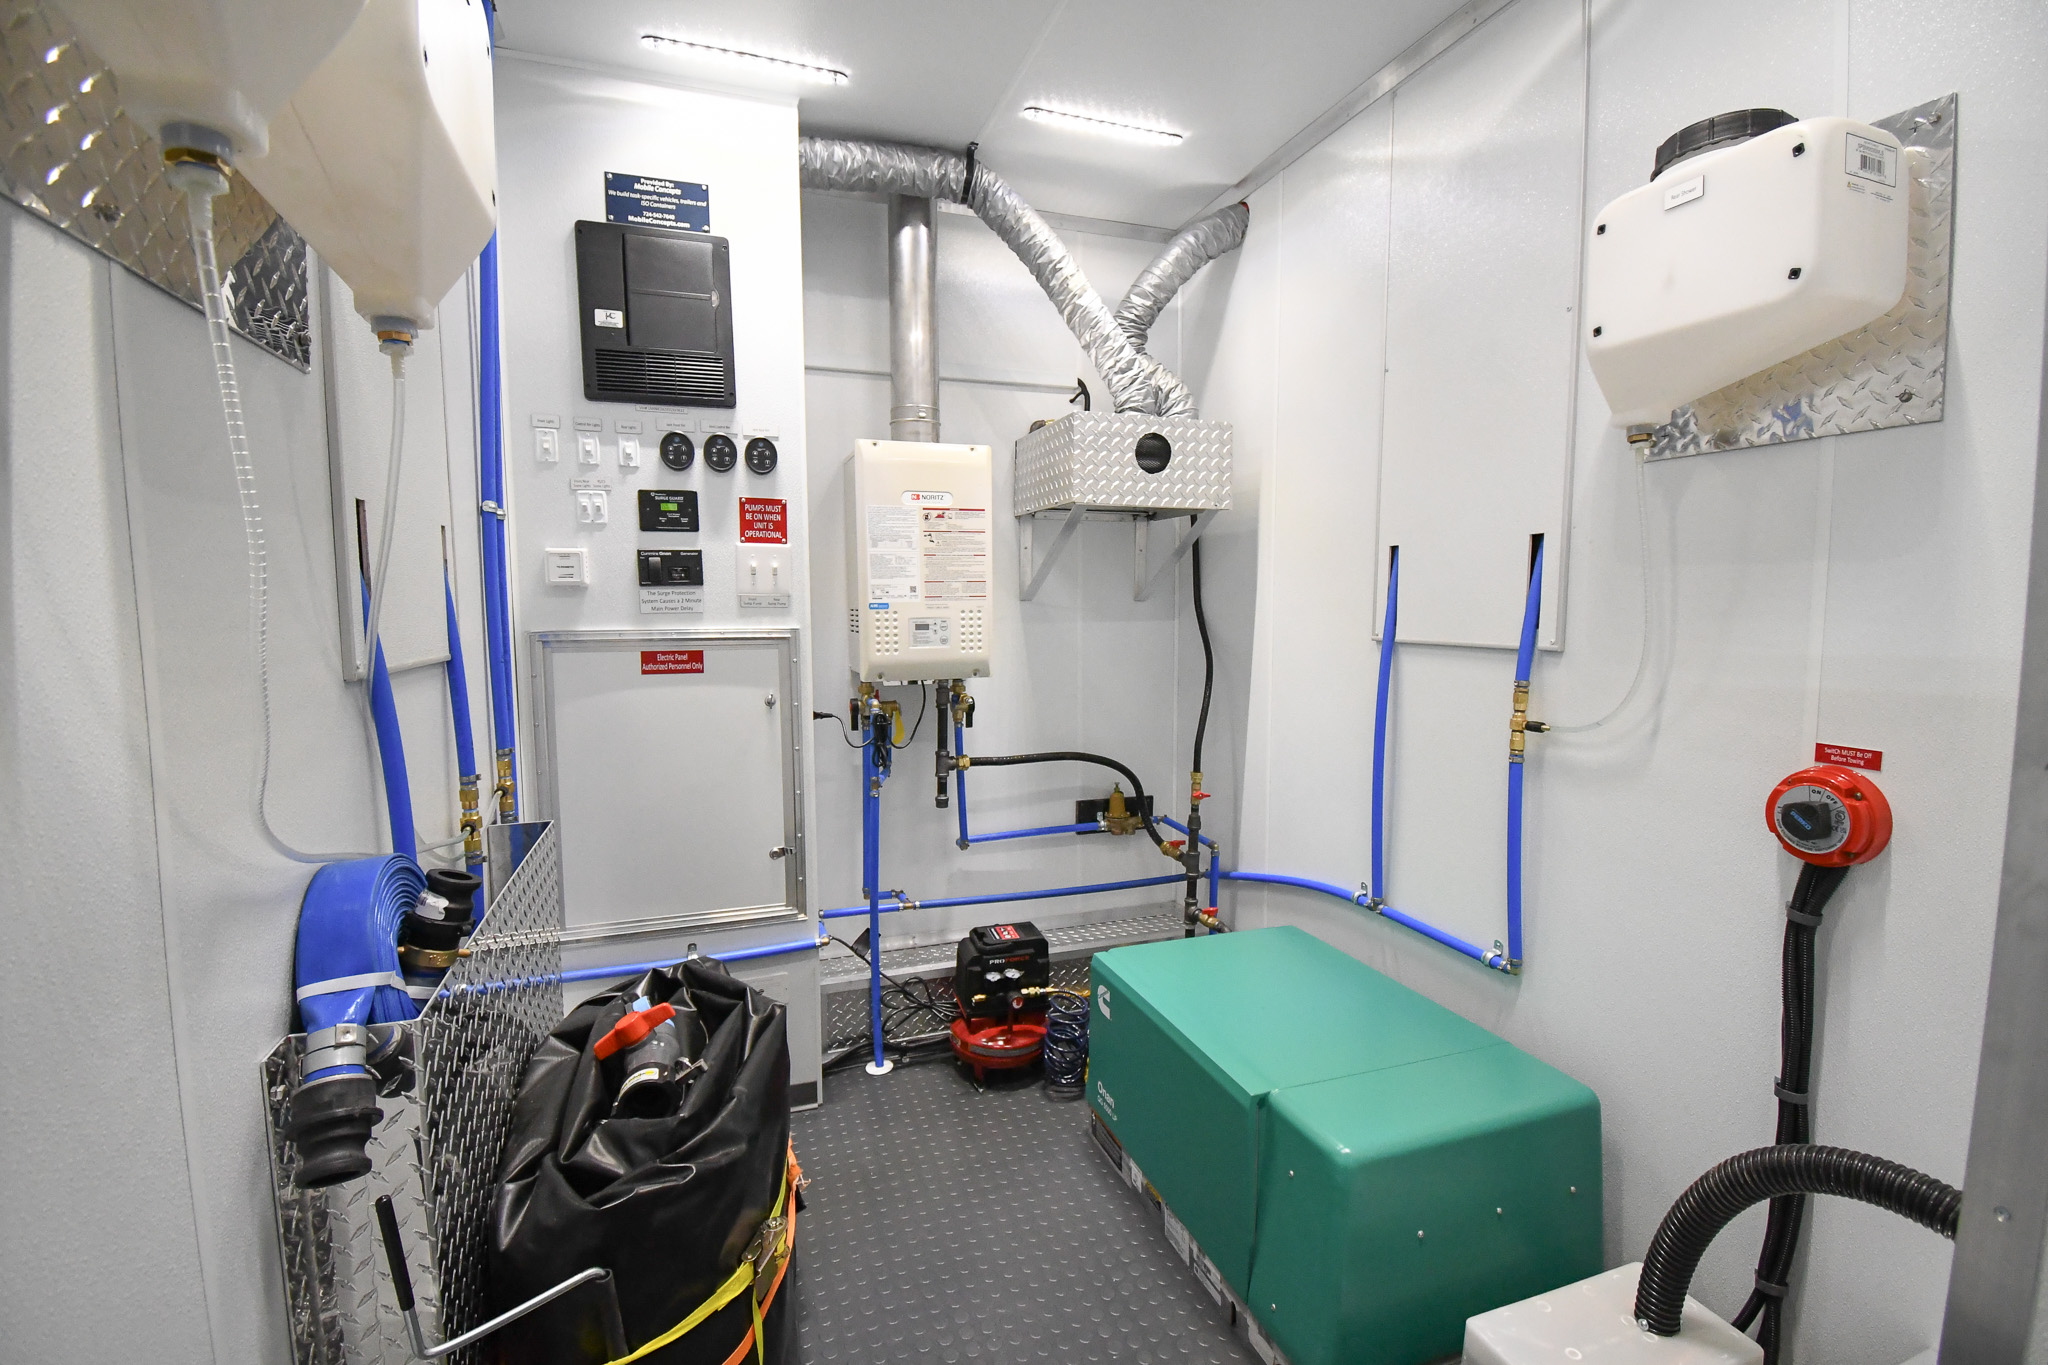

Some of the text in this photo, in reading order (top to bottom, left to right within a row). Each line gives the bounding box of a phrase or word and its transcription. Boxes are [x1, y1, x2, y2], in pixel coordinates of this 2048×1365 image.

[641, 178, 665, 186] Provided
[634, 183, 682, 195] Mobile Concepts
[630, 193, 660, 201] task-specific
[650, 202, 676, 210] Containers
[628, 215, 690, 228] MobileConcepts.com
[744, 530, 782, 538] OPERATIONAL
[692, 662, 703, 671] Only
[1848, 757, 1864, 766] Towing
[1826, 794, 1838, 804] OFF
[1097, 1080, 1114, 1109] Onan
